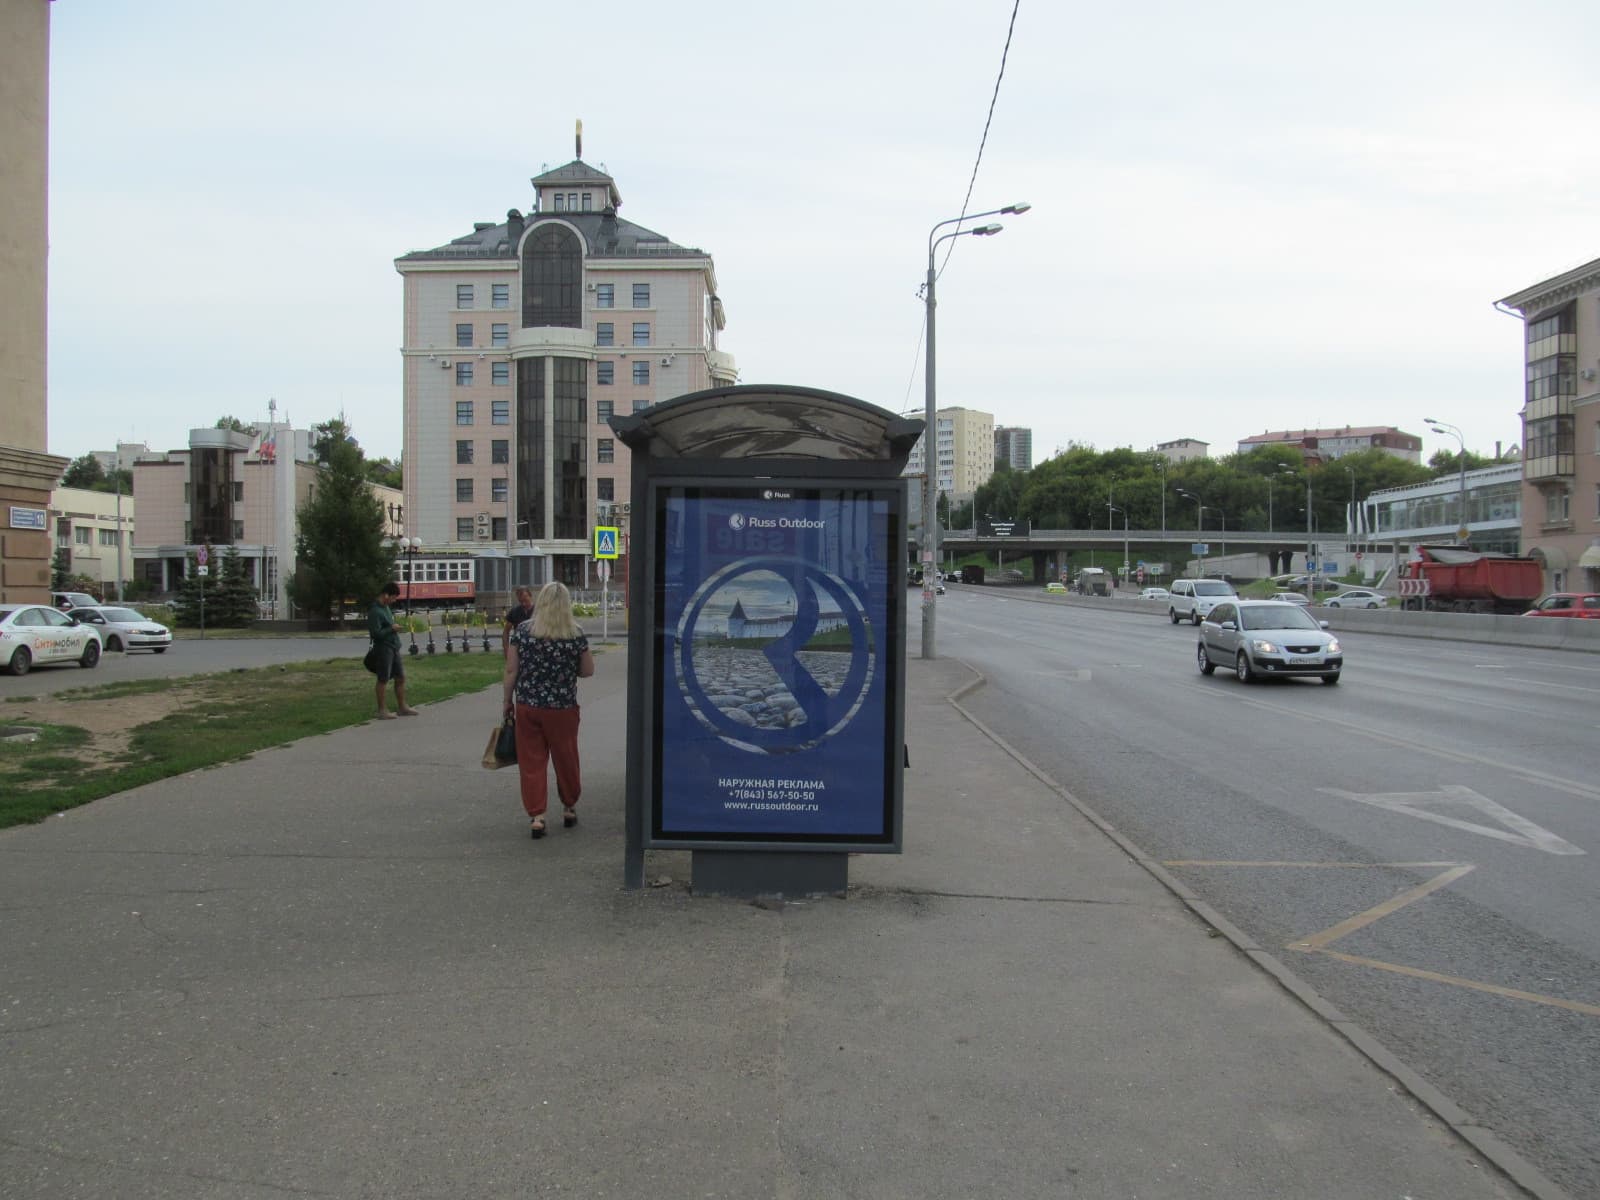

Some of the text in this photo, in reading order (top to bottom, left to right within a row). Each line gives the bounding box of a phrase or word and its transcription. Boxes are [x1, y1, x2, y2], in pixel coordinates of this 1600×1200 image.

[748, 517, 825, 529] Russ Outdoor
[718, 779, 825, 789] НАРУЖНАЯ РЕКЛАМА
[729, 790, 815, 800] +7(843) 567-50-50
[724, 802, 819, 811] www.russoutdoor.ru
